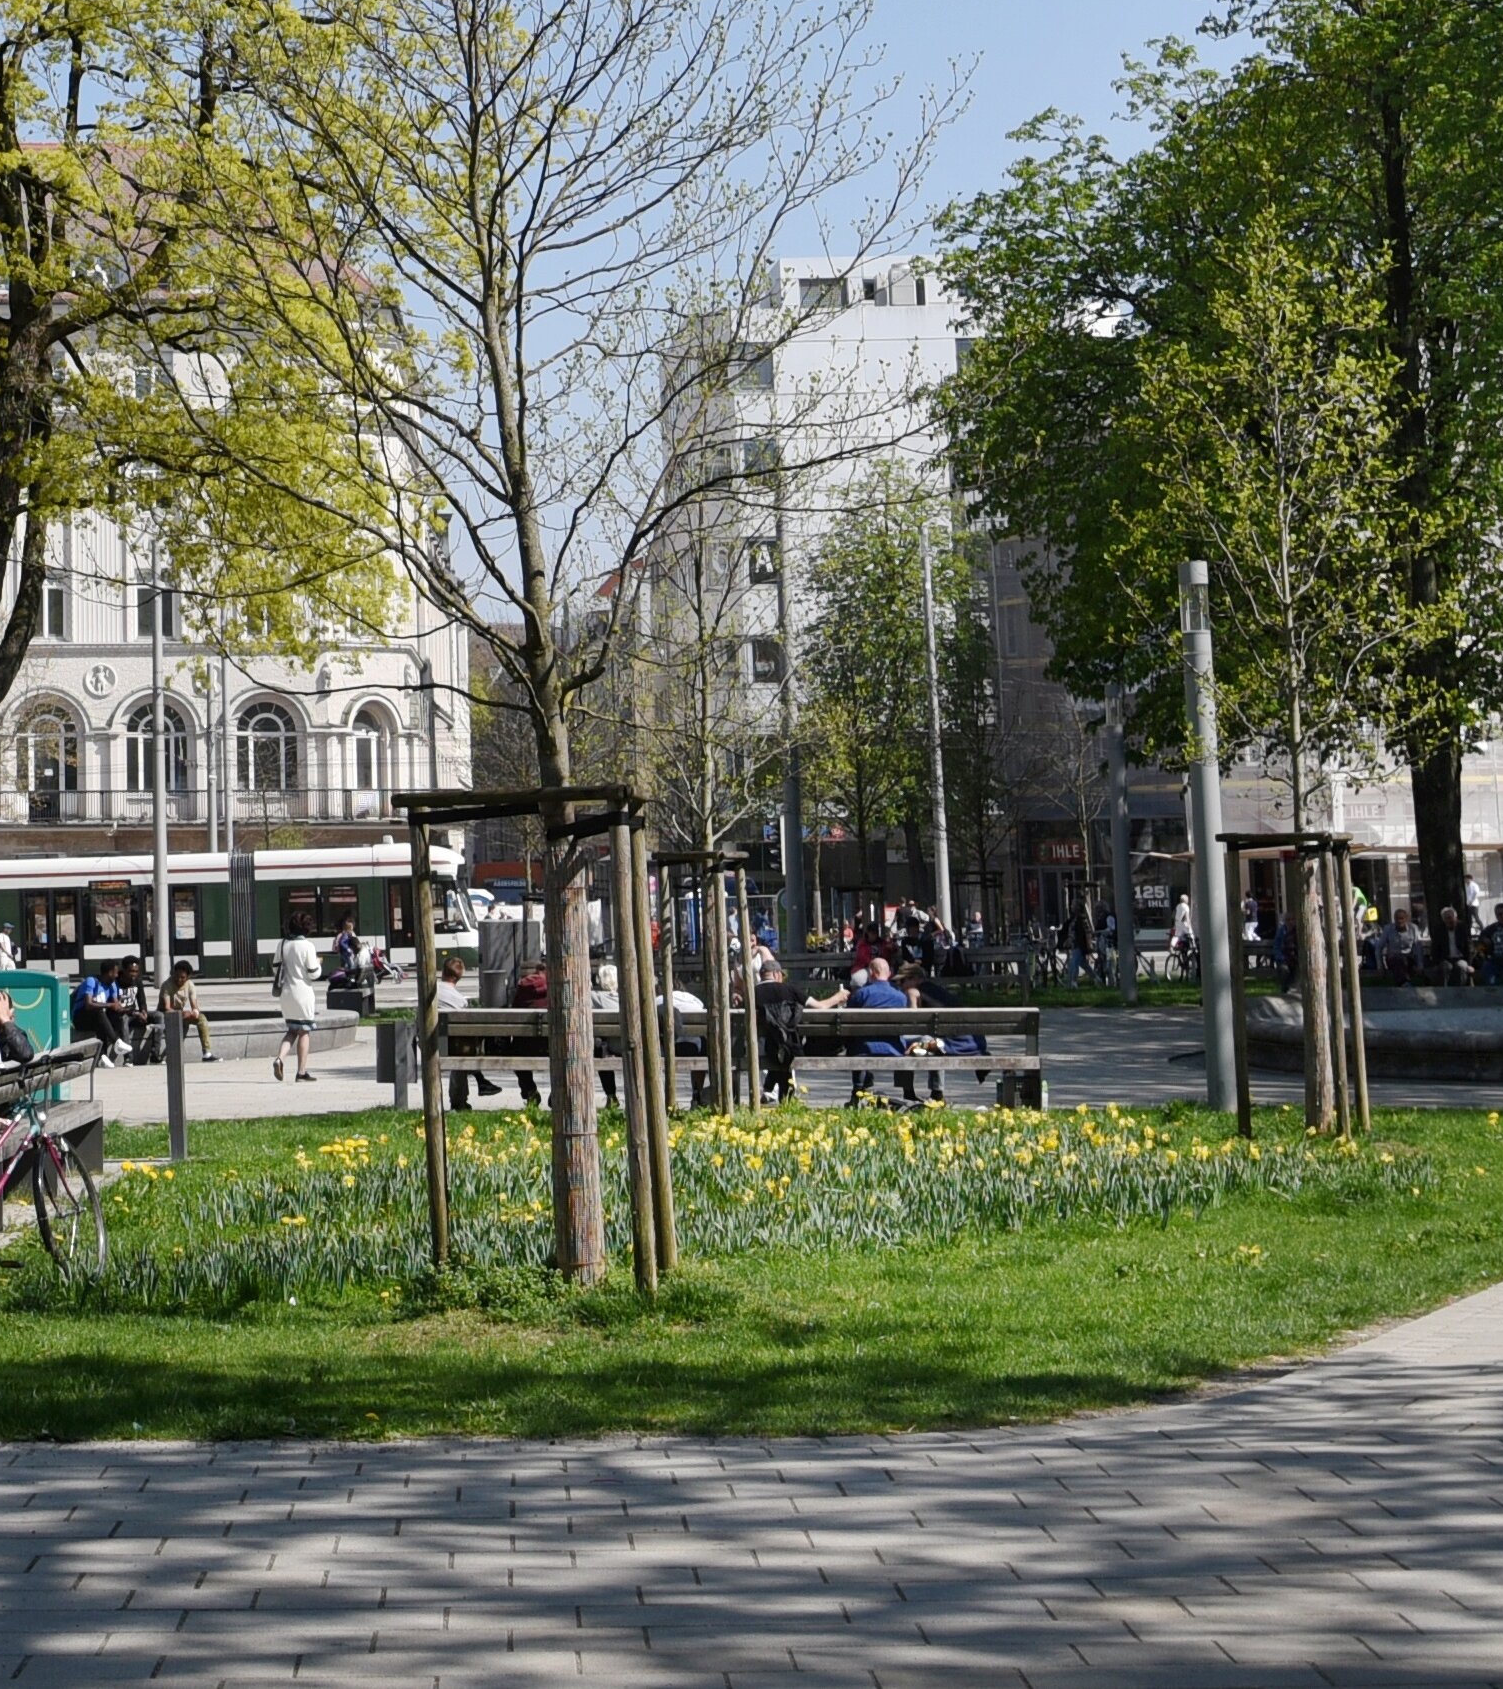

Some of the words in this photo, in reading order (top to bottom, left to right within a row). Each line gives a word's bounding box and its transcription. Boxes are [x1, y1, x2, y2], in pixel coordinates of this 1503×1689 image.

[1052, 844, 1080, 858] IHLE
[1134, 885, 1165, 899] 125
[1148, 899, 1170, 908] IHLE
